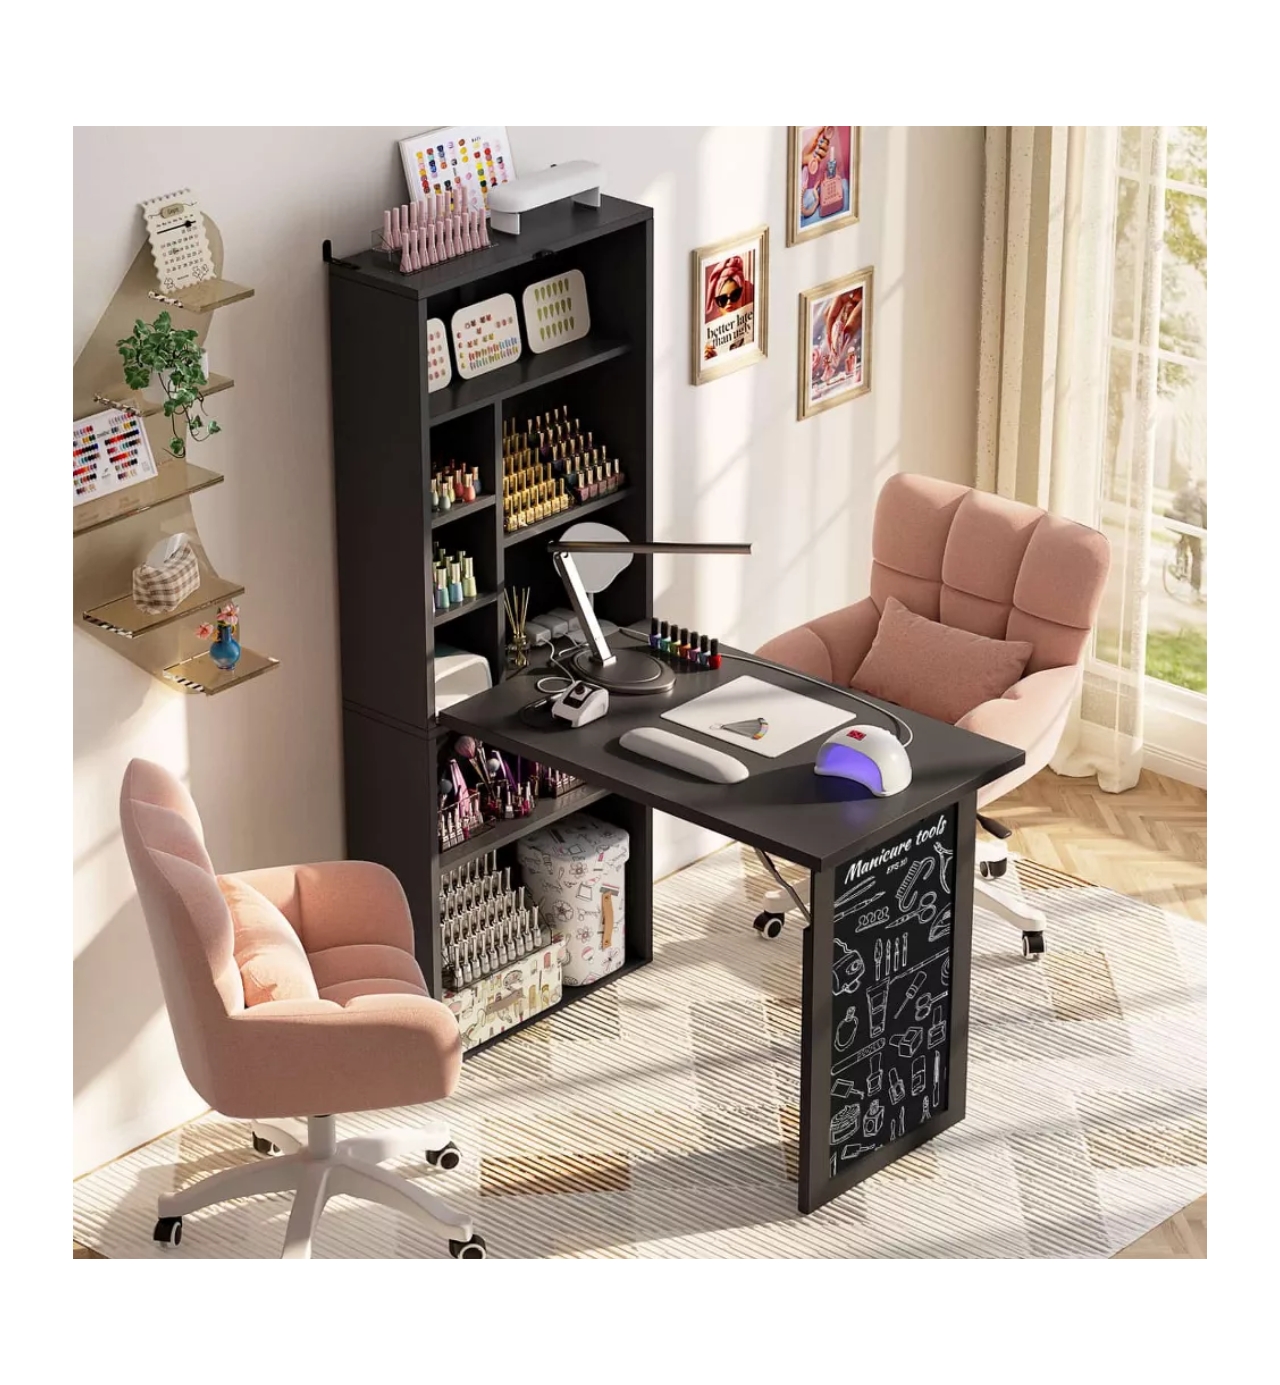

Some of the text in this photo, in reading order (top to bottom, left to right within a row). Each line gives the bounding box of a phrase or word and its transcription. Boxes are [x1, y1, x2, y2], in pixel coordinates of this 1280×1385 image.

[707, 311, 753, 339] better late
[712, 322, 751, 347] than ugly
[844, 814, 947, 885] Manicure tools
